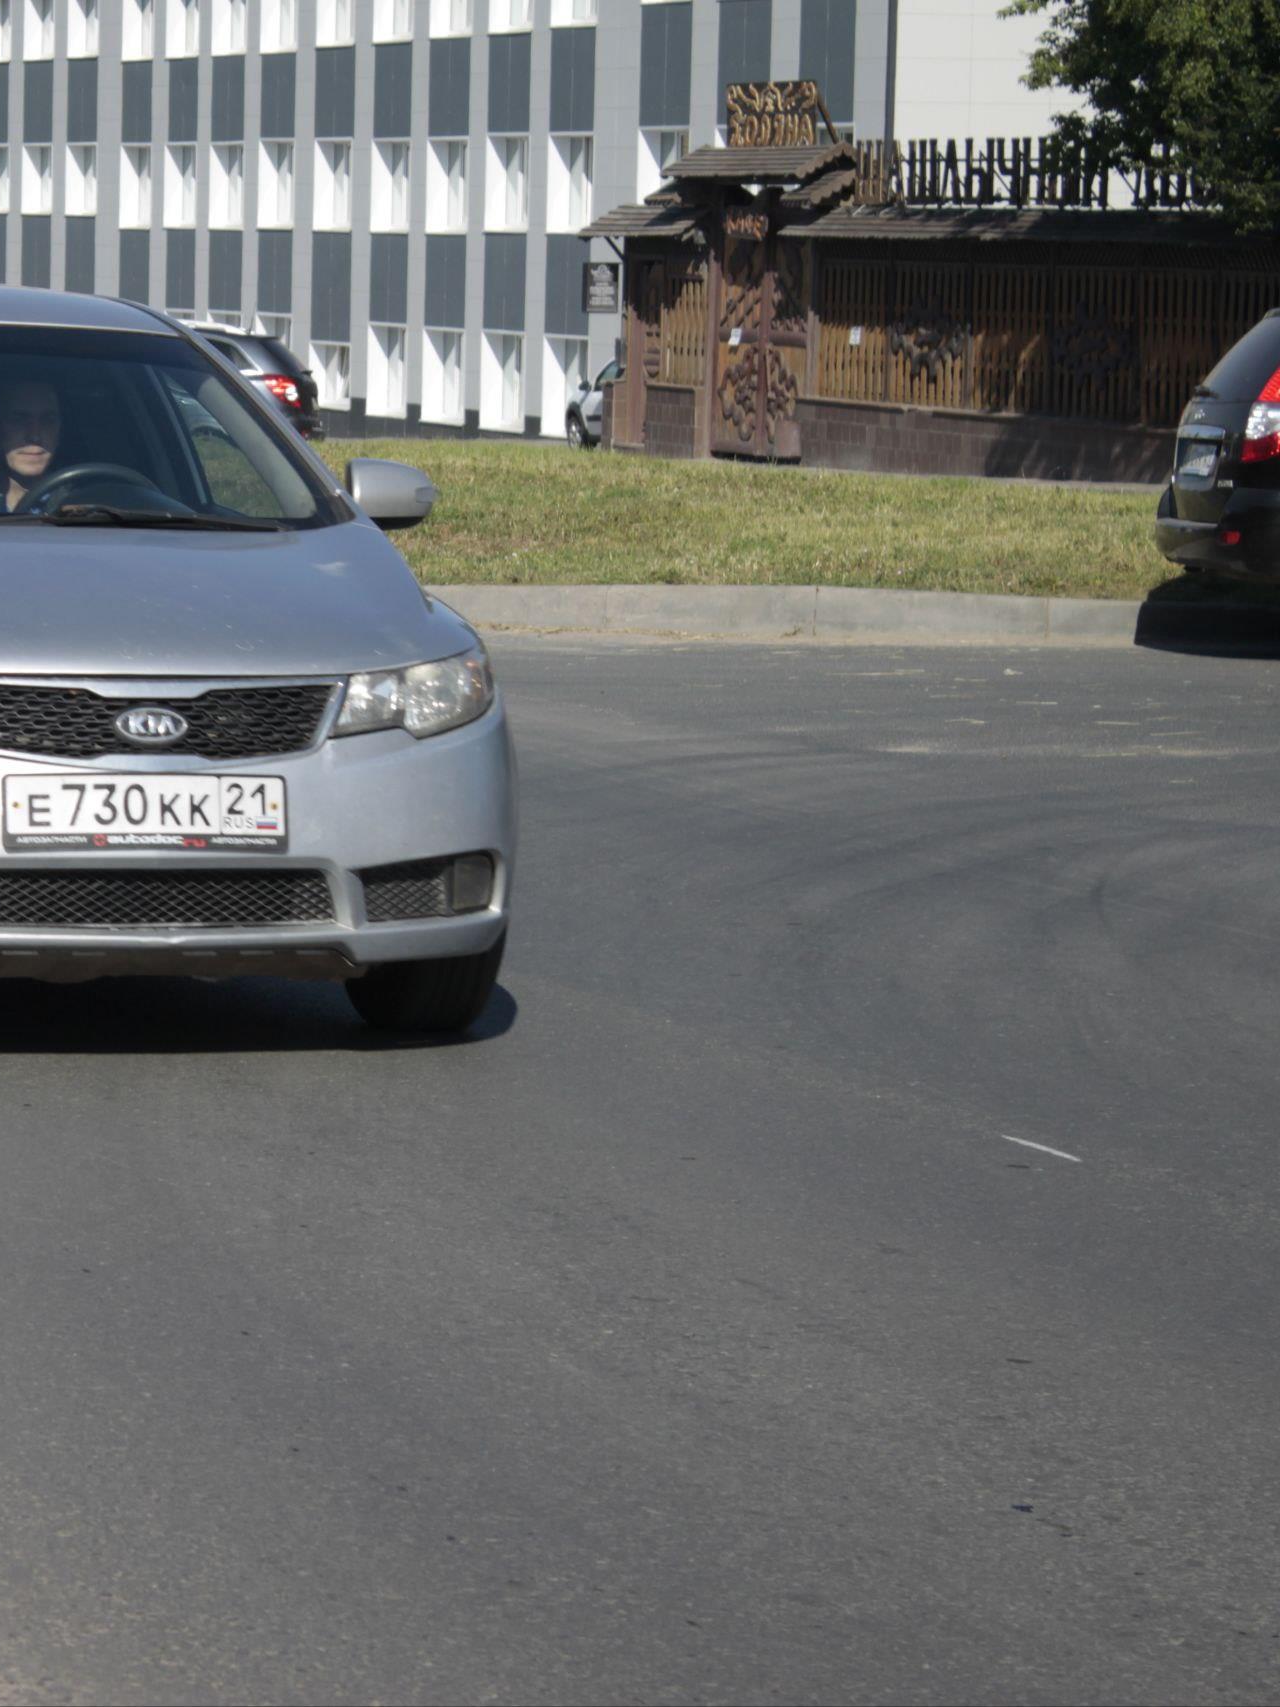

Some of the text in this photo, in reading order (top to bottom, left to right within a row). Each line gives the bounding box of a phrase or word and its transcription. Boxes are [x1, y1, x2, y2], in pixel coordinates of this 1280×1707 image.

[128, 714, 177, 735] KIA
[226, 783, 267, 816] 21
[223, 816, 254, 830] RUS
